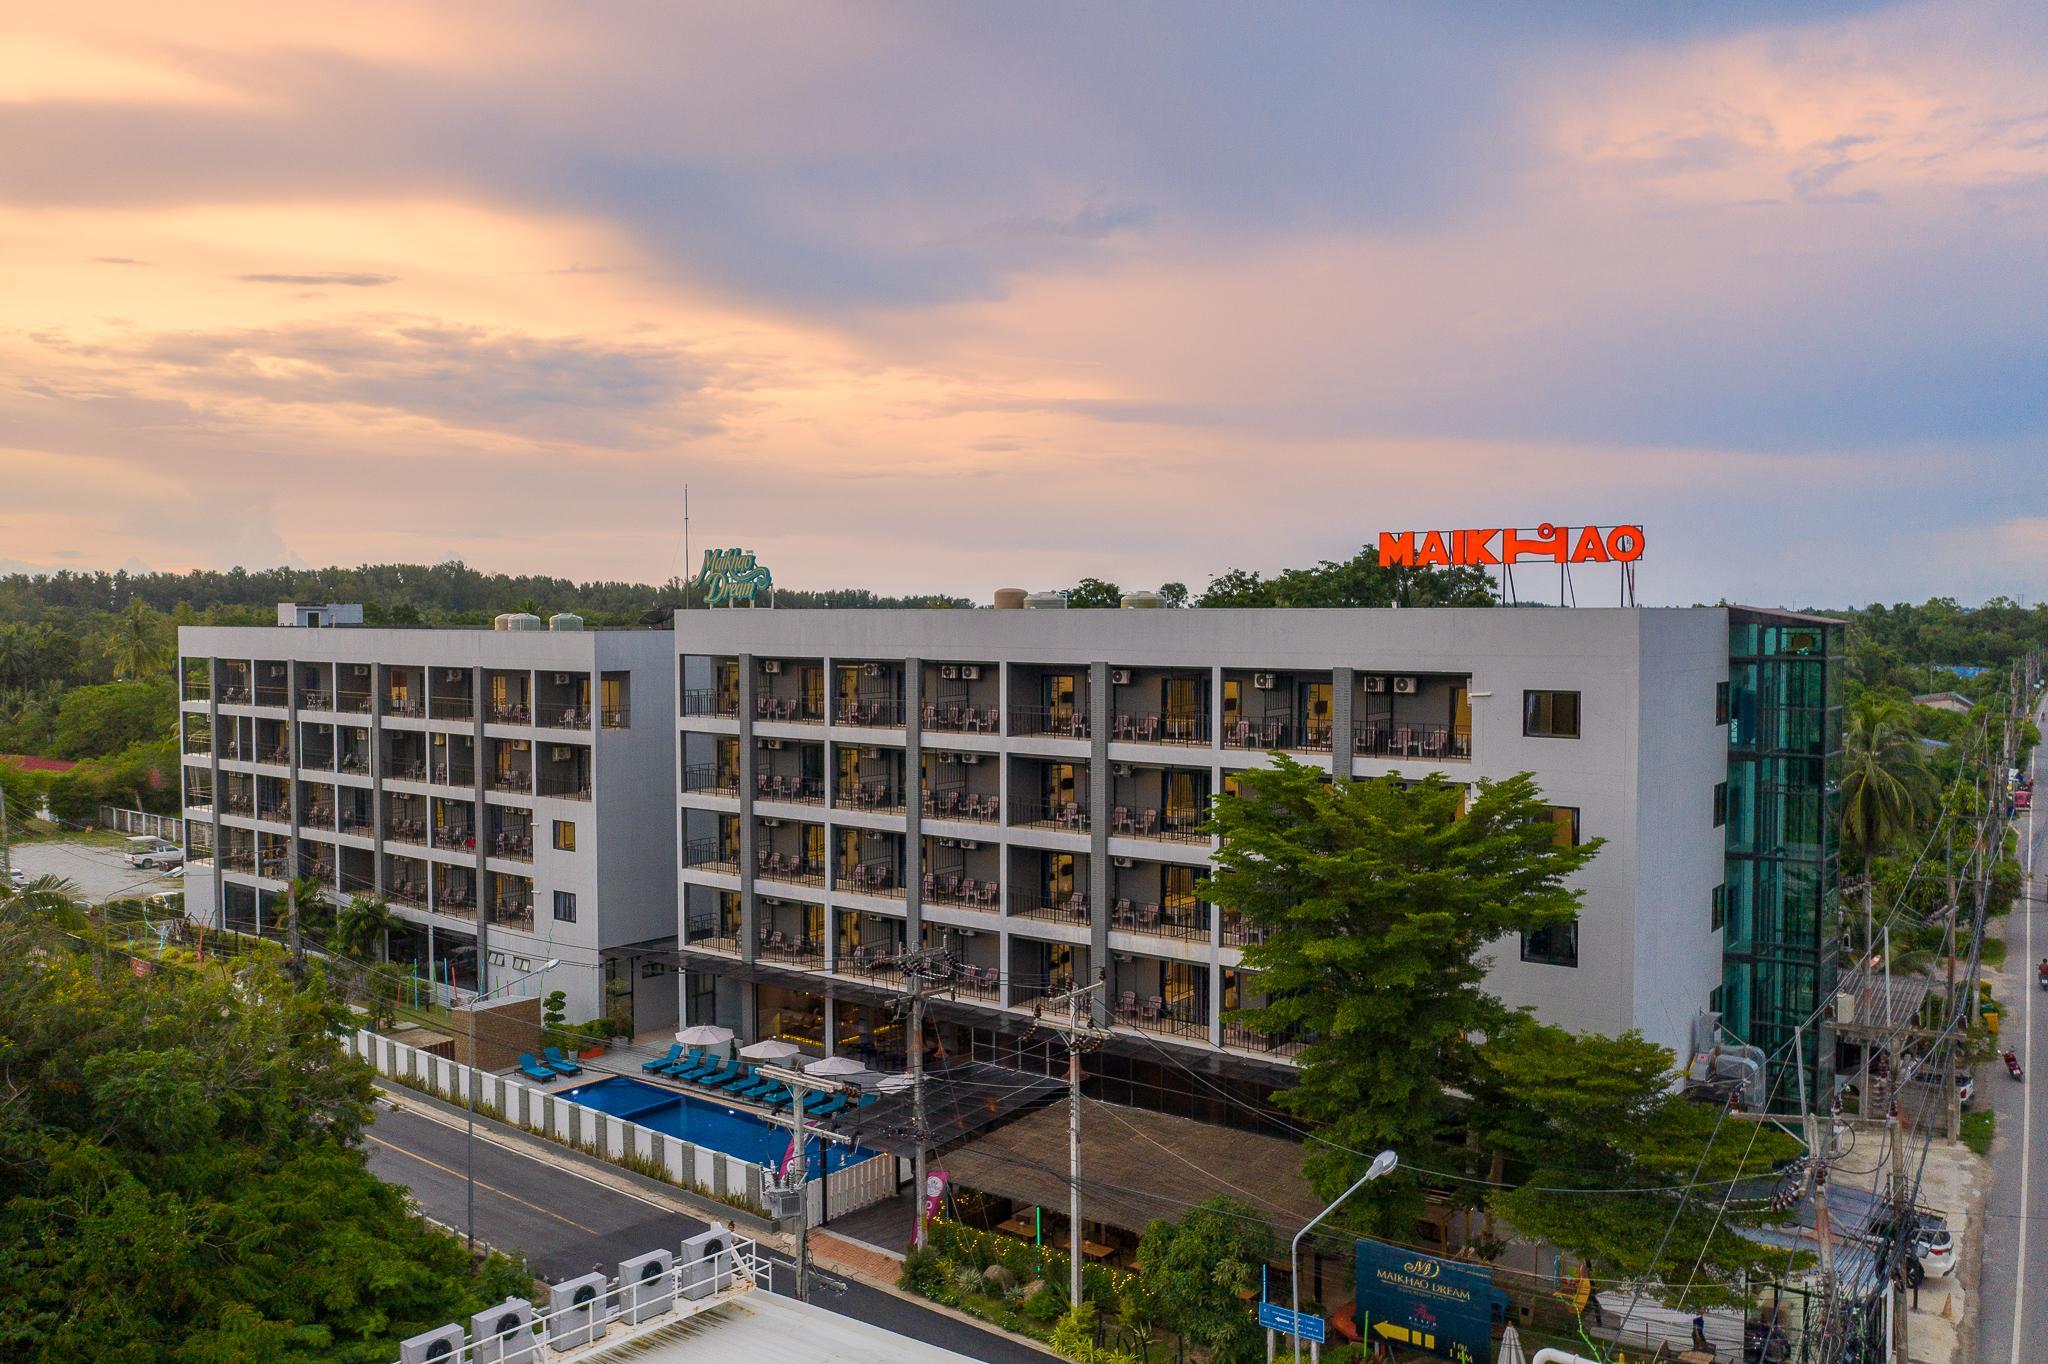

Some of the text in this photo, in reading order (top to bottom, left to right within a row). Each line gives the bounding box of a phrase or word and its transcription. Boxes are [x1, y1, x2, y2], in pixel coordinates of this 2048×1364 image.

[1379, 523, 1645, 567] MAIKHAO
[704, 573, 756, 604] Dream
[1376, 1269, 1429, 1290] MAIKHAO
[1432, 1283, 1471, 1301] DREAM
